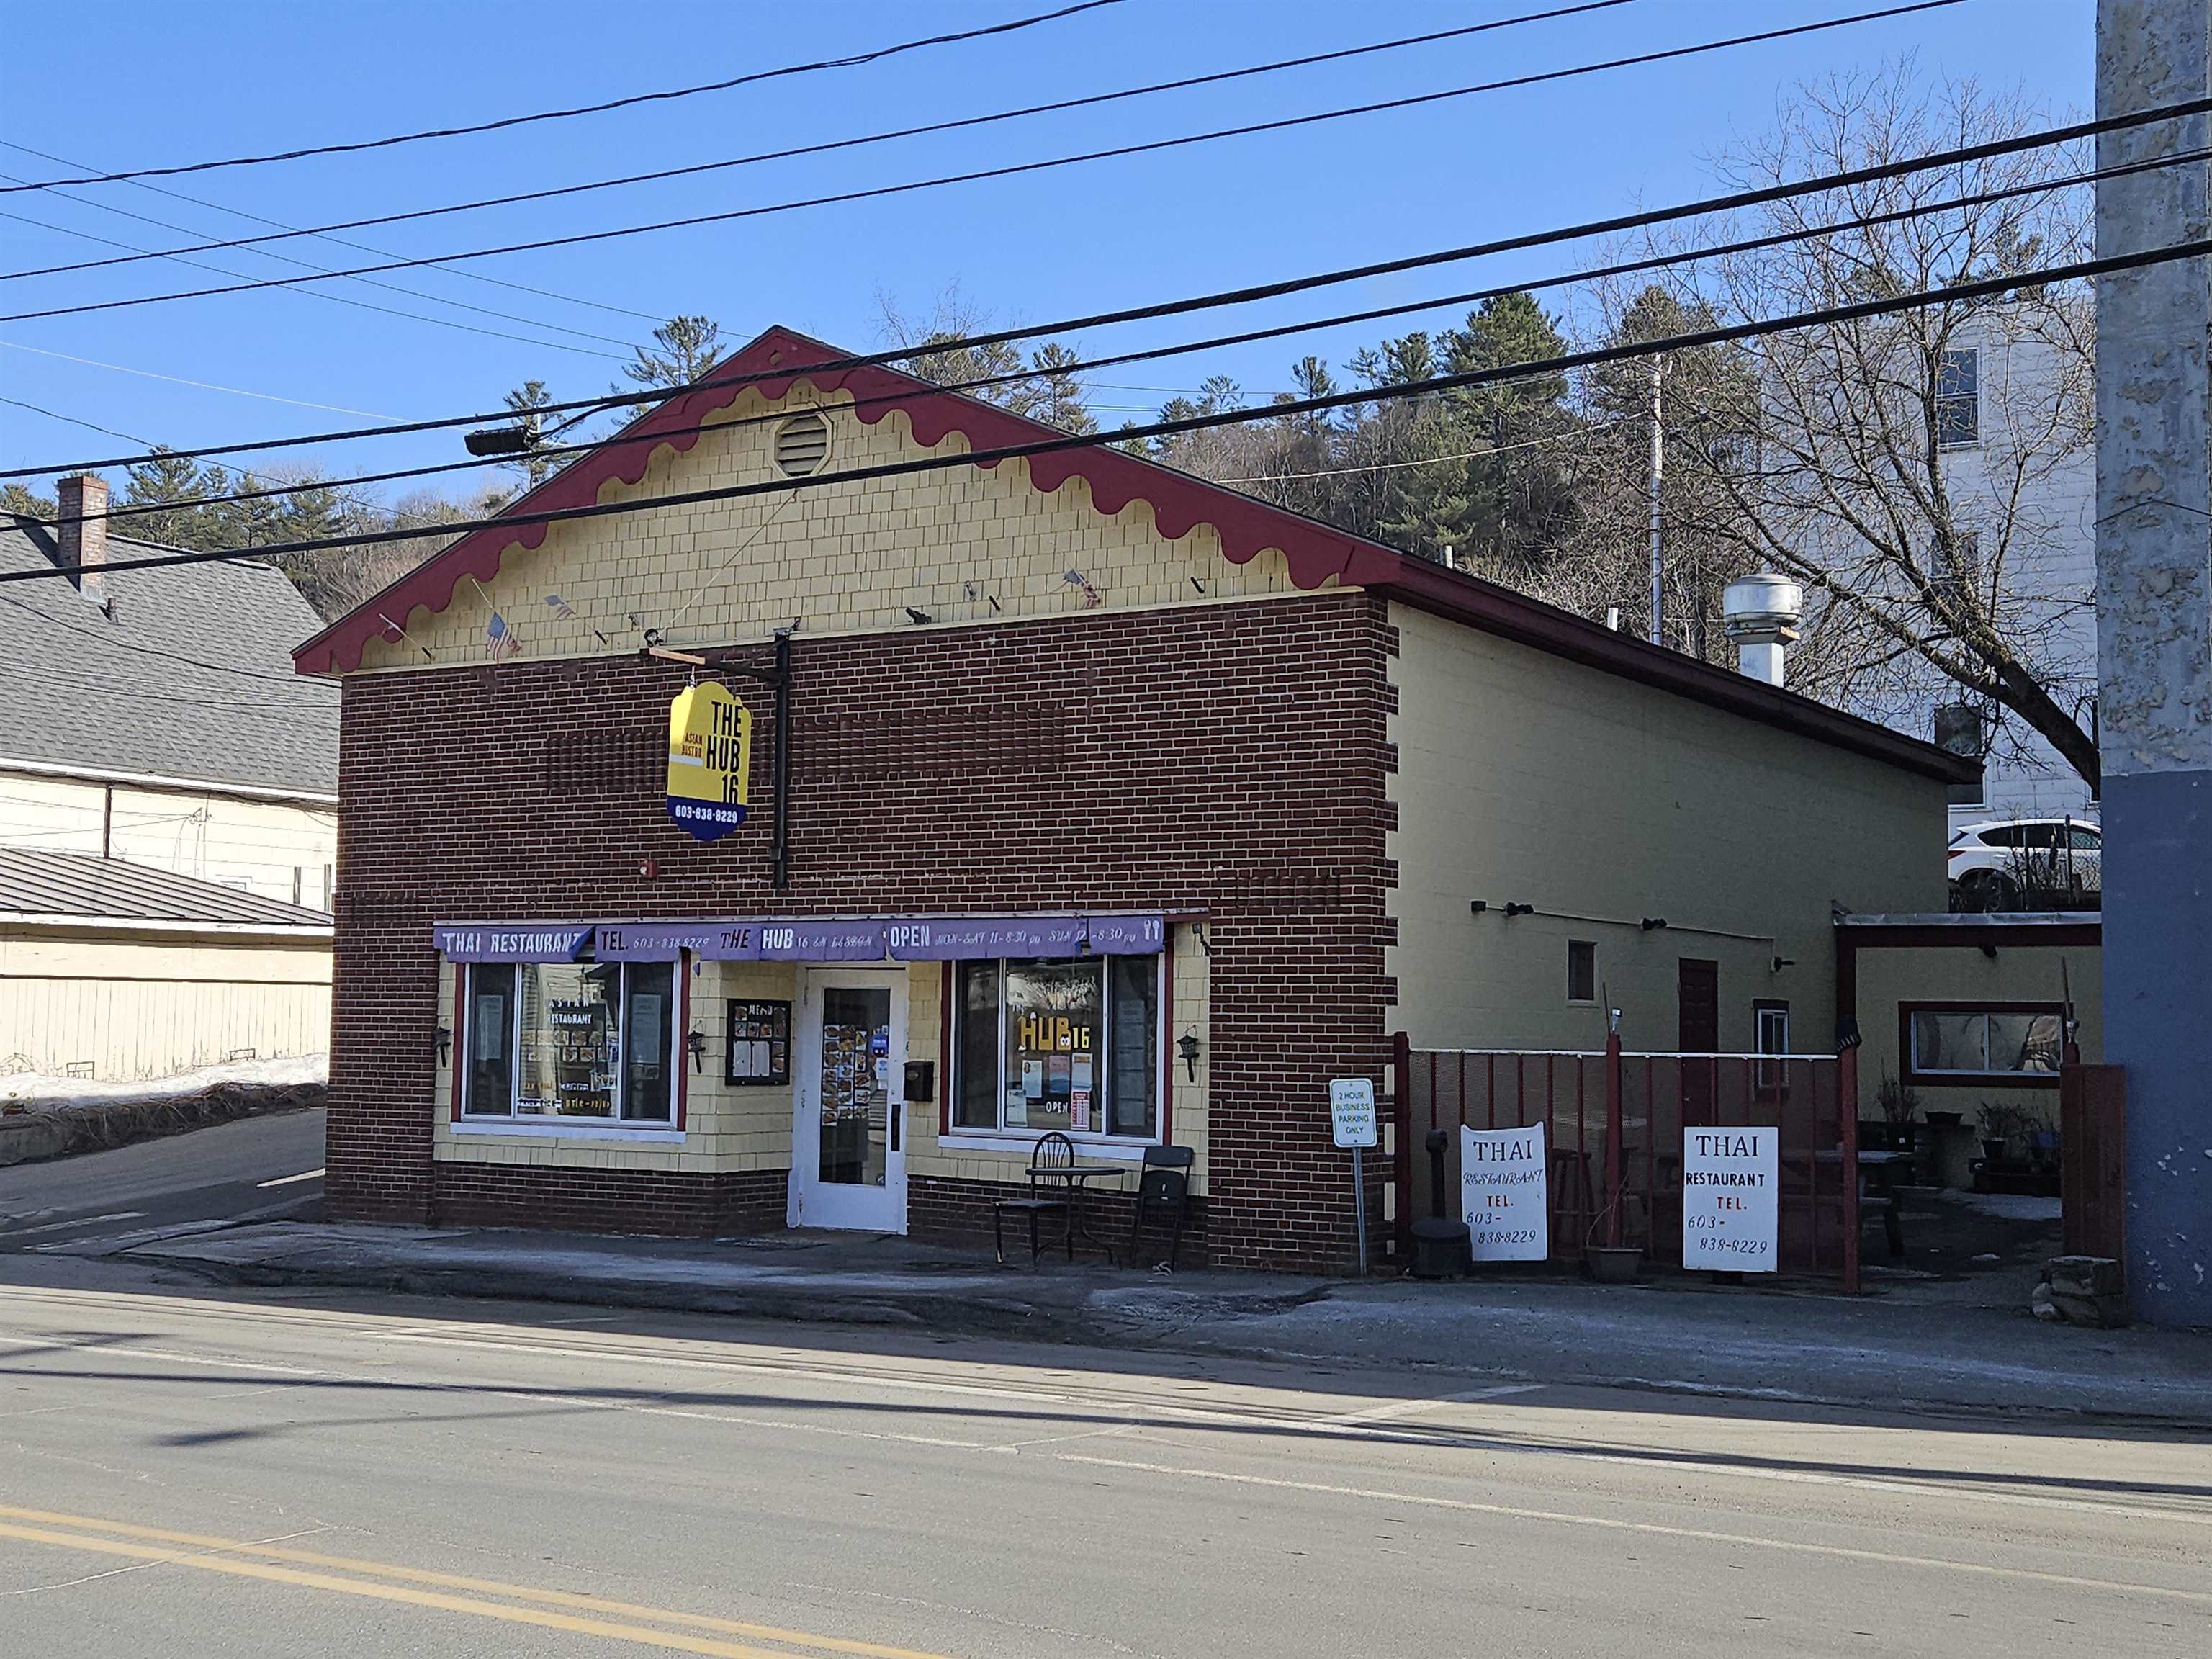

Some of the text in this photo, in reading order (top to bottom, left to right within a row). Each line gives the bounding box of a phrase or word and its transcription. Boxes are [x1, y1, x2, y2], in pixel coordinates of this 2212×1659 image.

[711, 701, 743, 738] THE
[685, 732, 703, 746] ASIAN
[706, 734, 740, 773] HUB
[721, 774, 739, 804] 16
[675, 804, 737, 823] 603-838-8229
[442, 932, 481, 953] THAI
[490, 932, 580, 953] RESTAURANT
[601, 930, 629, 950] TEL.
[721, 929, 751, 949] THE
[762, 928, 793, 949] HUB
[798, 936, 809, 948] 16
[890, 925, 930, 947] OPEN
[1048, 930, 1071, 942] SUN
[548, 1013, 592, 1024] RESTAURANT
[1020, 1017, 1089, 1050] HUB 16
[1046, 1101, 1069, 1112] OPEN
[1473, 1140, 1532, 1161] THAI
[1696, 1136, 1758, 1156] THAI
[1463, 1169, 1543, 1185] RESTAURANT
[1686, 1172, 1764, 1187] RESTAURANT
[1487, 1195, 1514, 1208] TEL.
[1717, 1197, 1748, 1210] TEL.
[1467, 1212, 1501, 1224] 603-
[1688, 1215, 1725, 1228] 603-
[1478, 1230, 1536, 1244] 838-8229
[1700, 1237, 1768, 1254] 838-8229
